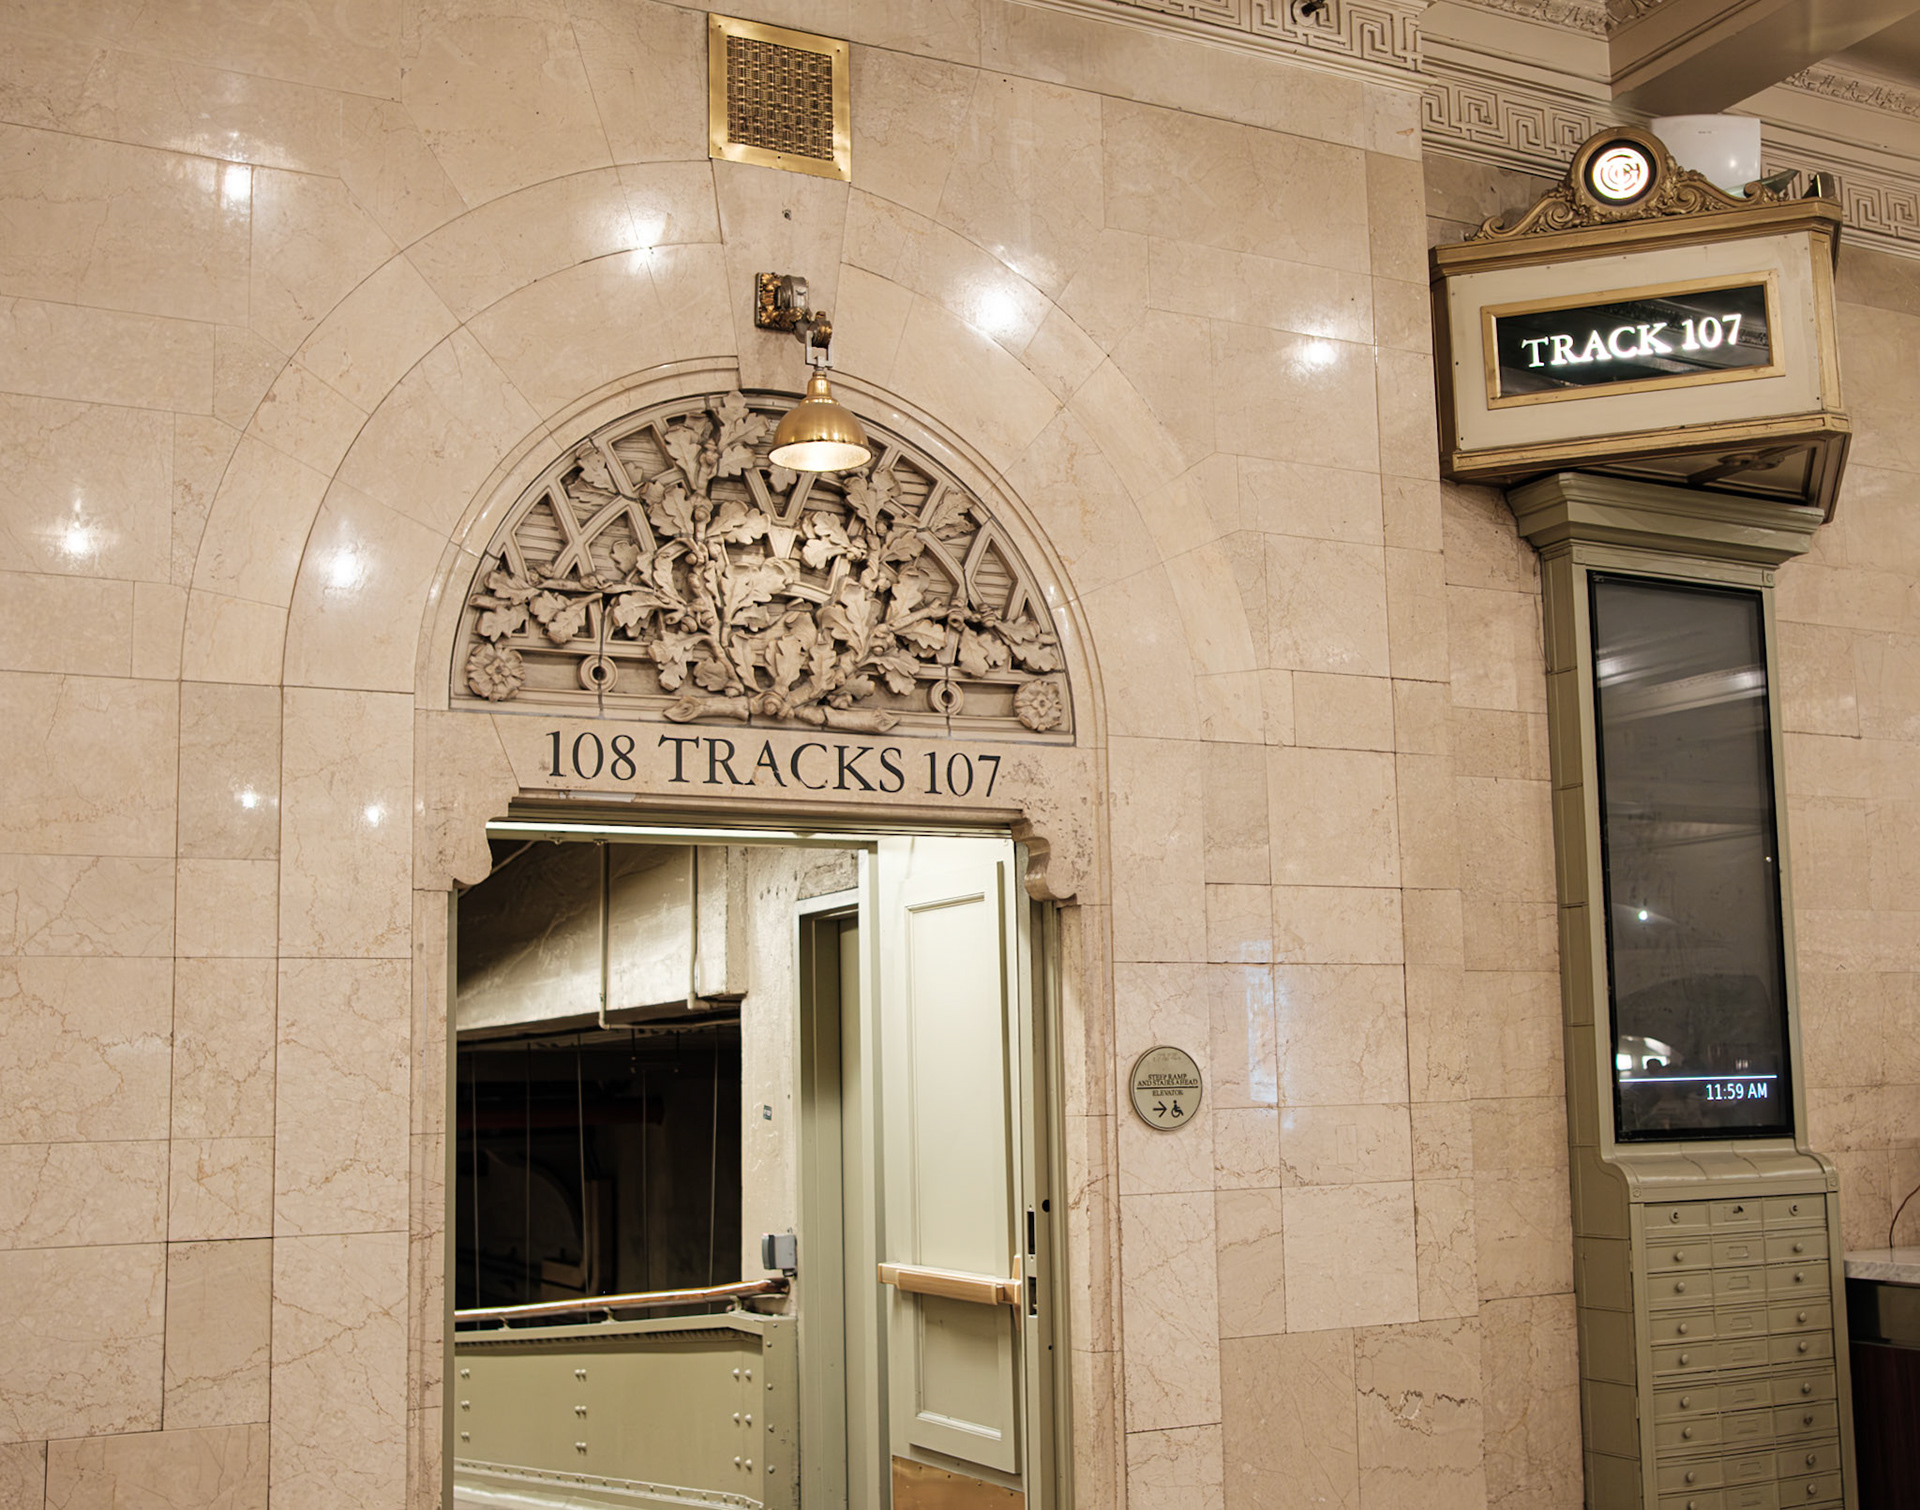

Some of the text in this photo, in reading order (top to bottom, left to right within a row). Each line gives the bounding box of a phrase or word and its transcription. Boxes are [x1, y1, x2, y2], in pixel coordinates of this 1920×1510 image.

[1521, 313, 1742, 368] TRACK 107
[545, 730, 1002, 797] 108 TRACKS 107
[1148, 1073, 1167, 1081] STEEP
[1176, 1078, 1199, 1086] AHEAD
[1152, 1089, 1184, 1097] ELEVATOR
[1705, 1082, 1768, 1101] 11:59 AM
